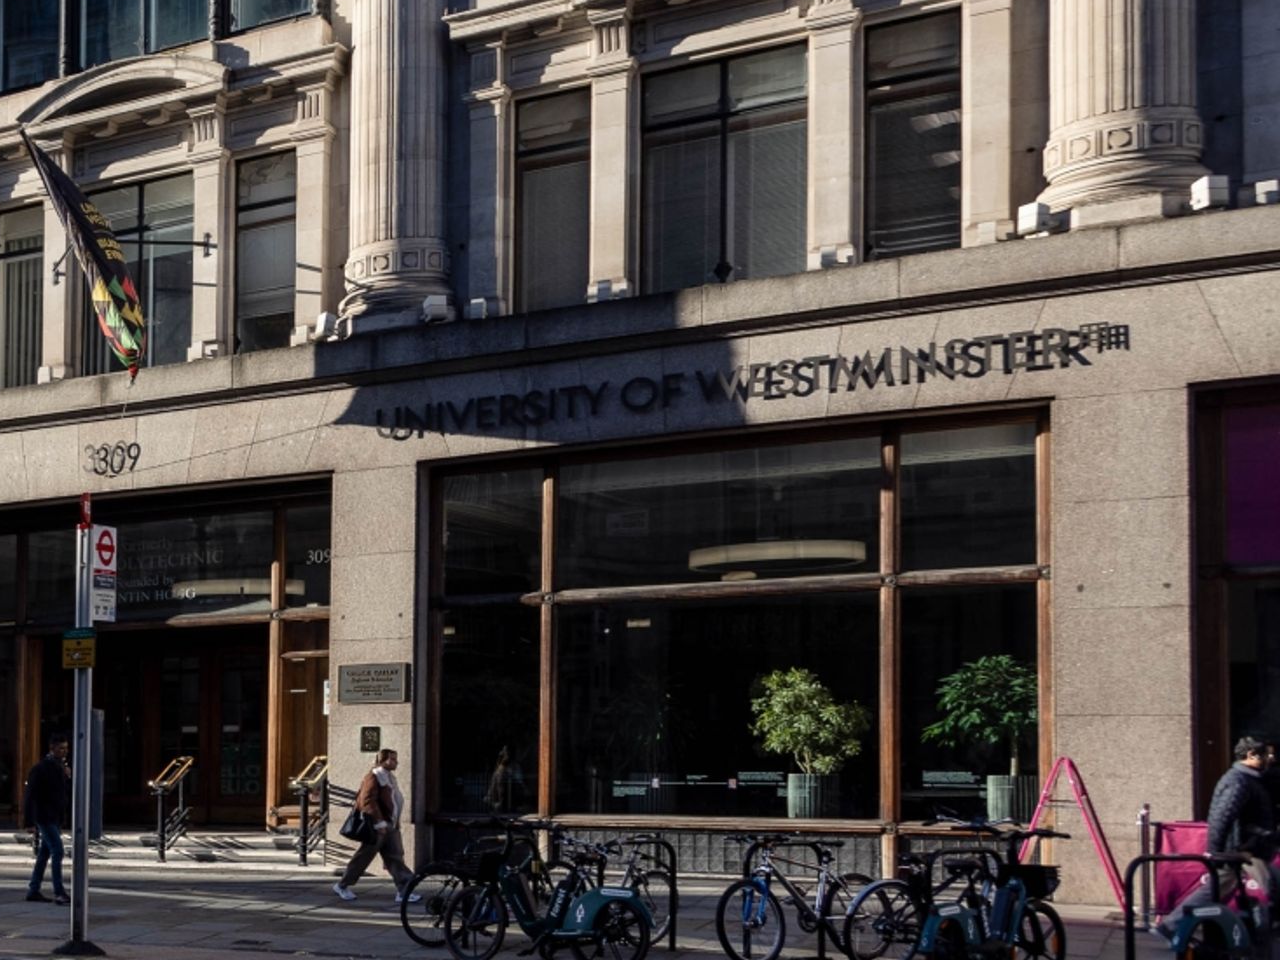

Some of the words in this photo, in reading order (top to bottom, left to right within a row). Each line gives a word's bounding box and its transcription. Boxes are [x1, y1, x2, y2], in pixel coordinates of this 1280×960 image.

[375, 380, 610, 442] UNIVERSITY
[619, 372, 685, 415] OF
[696, 327, 1093, 404] WESTMINSTER
[118, 549, 224, 569] OLYTECHNIC
